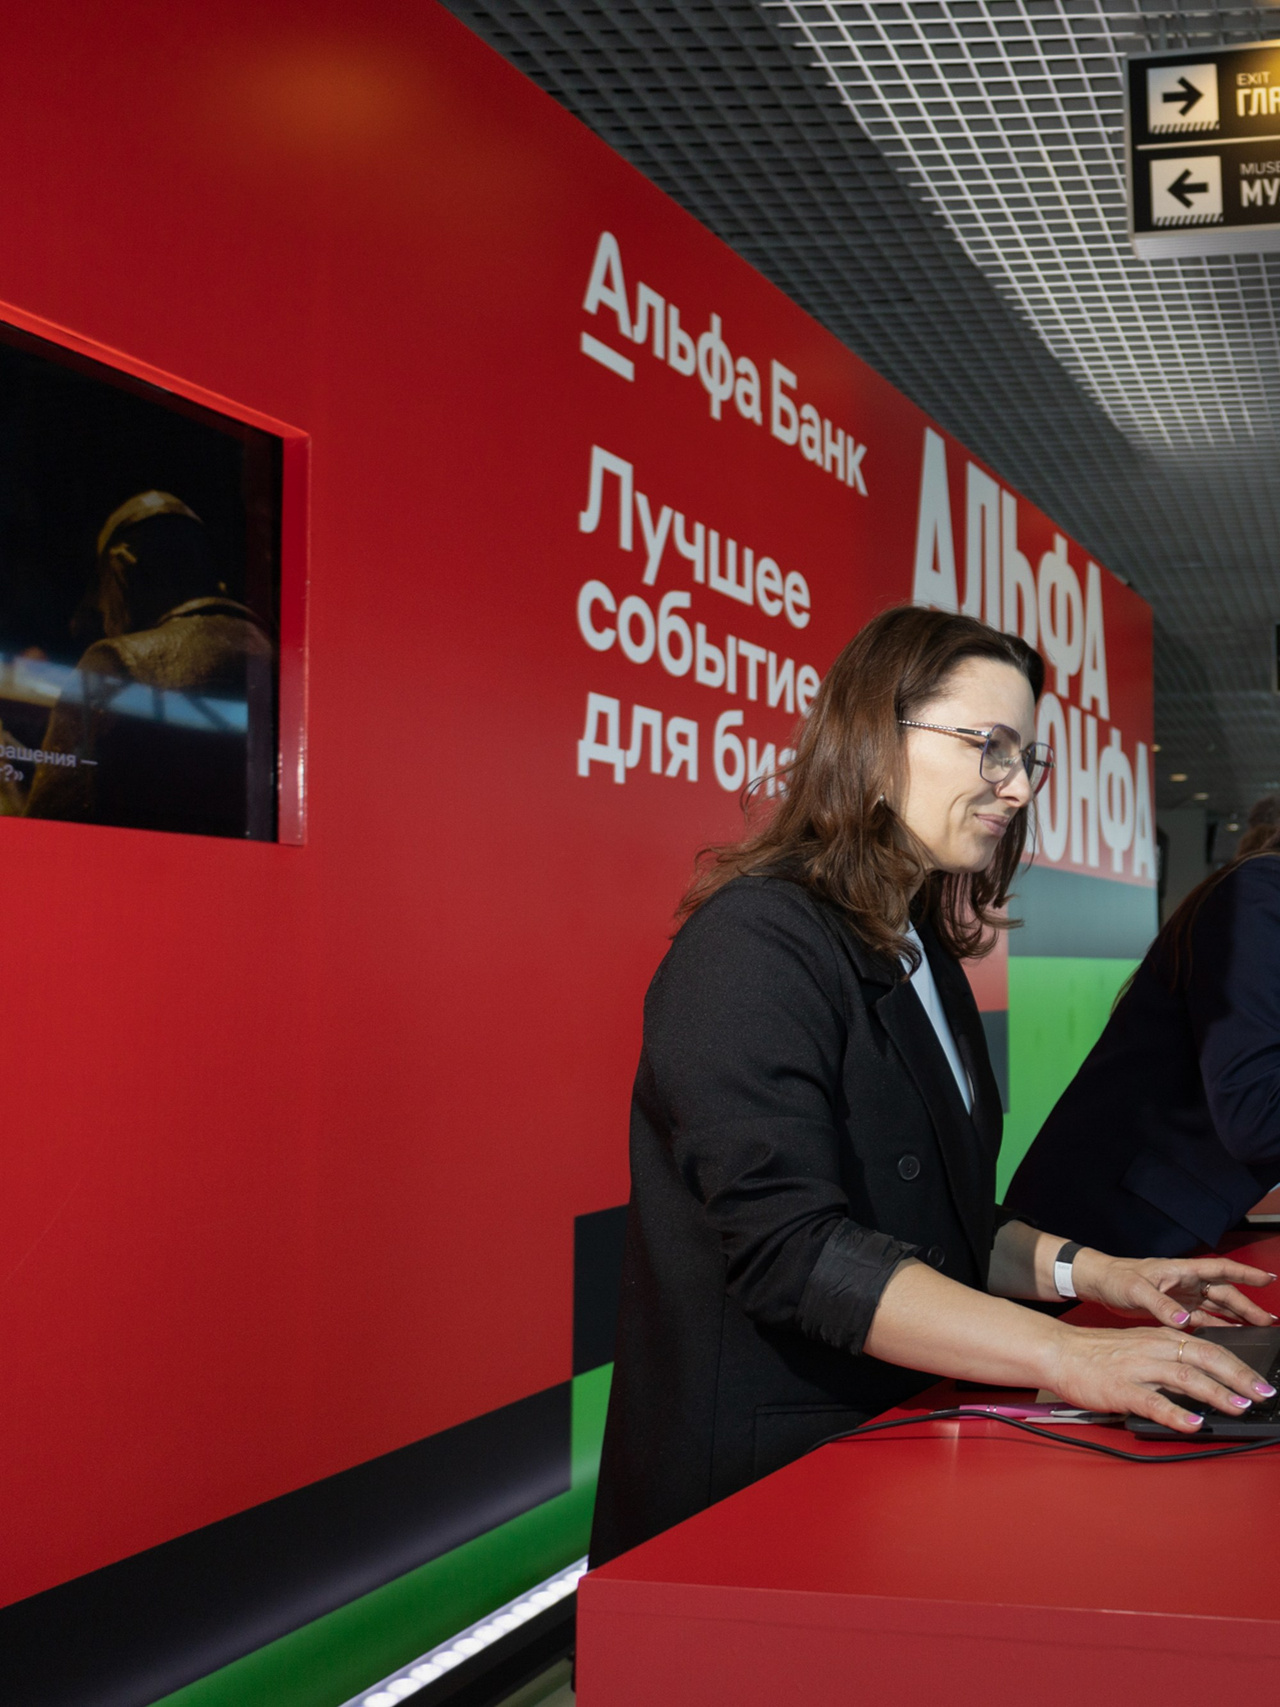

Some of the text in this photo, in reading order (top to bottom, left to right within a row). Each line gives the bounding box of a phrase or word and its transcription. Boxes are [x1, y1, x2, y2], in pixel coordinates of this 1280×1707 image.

[1236, 71, 1270, 86] EXIT
[580, 230, 868, 497] Альфа Банк
[579, 444, 811, 629] Лучшее
[911, 426, 1110, 721] АЛЬФА
[577, 579, 822, 720] событие
[577, 691, 698, 784] для
[1025, 691, 1158, 880] ОНФА
